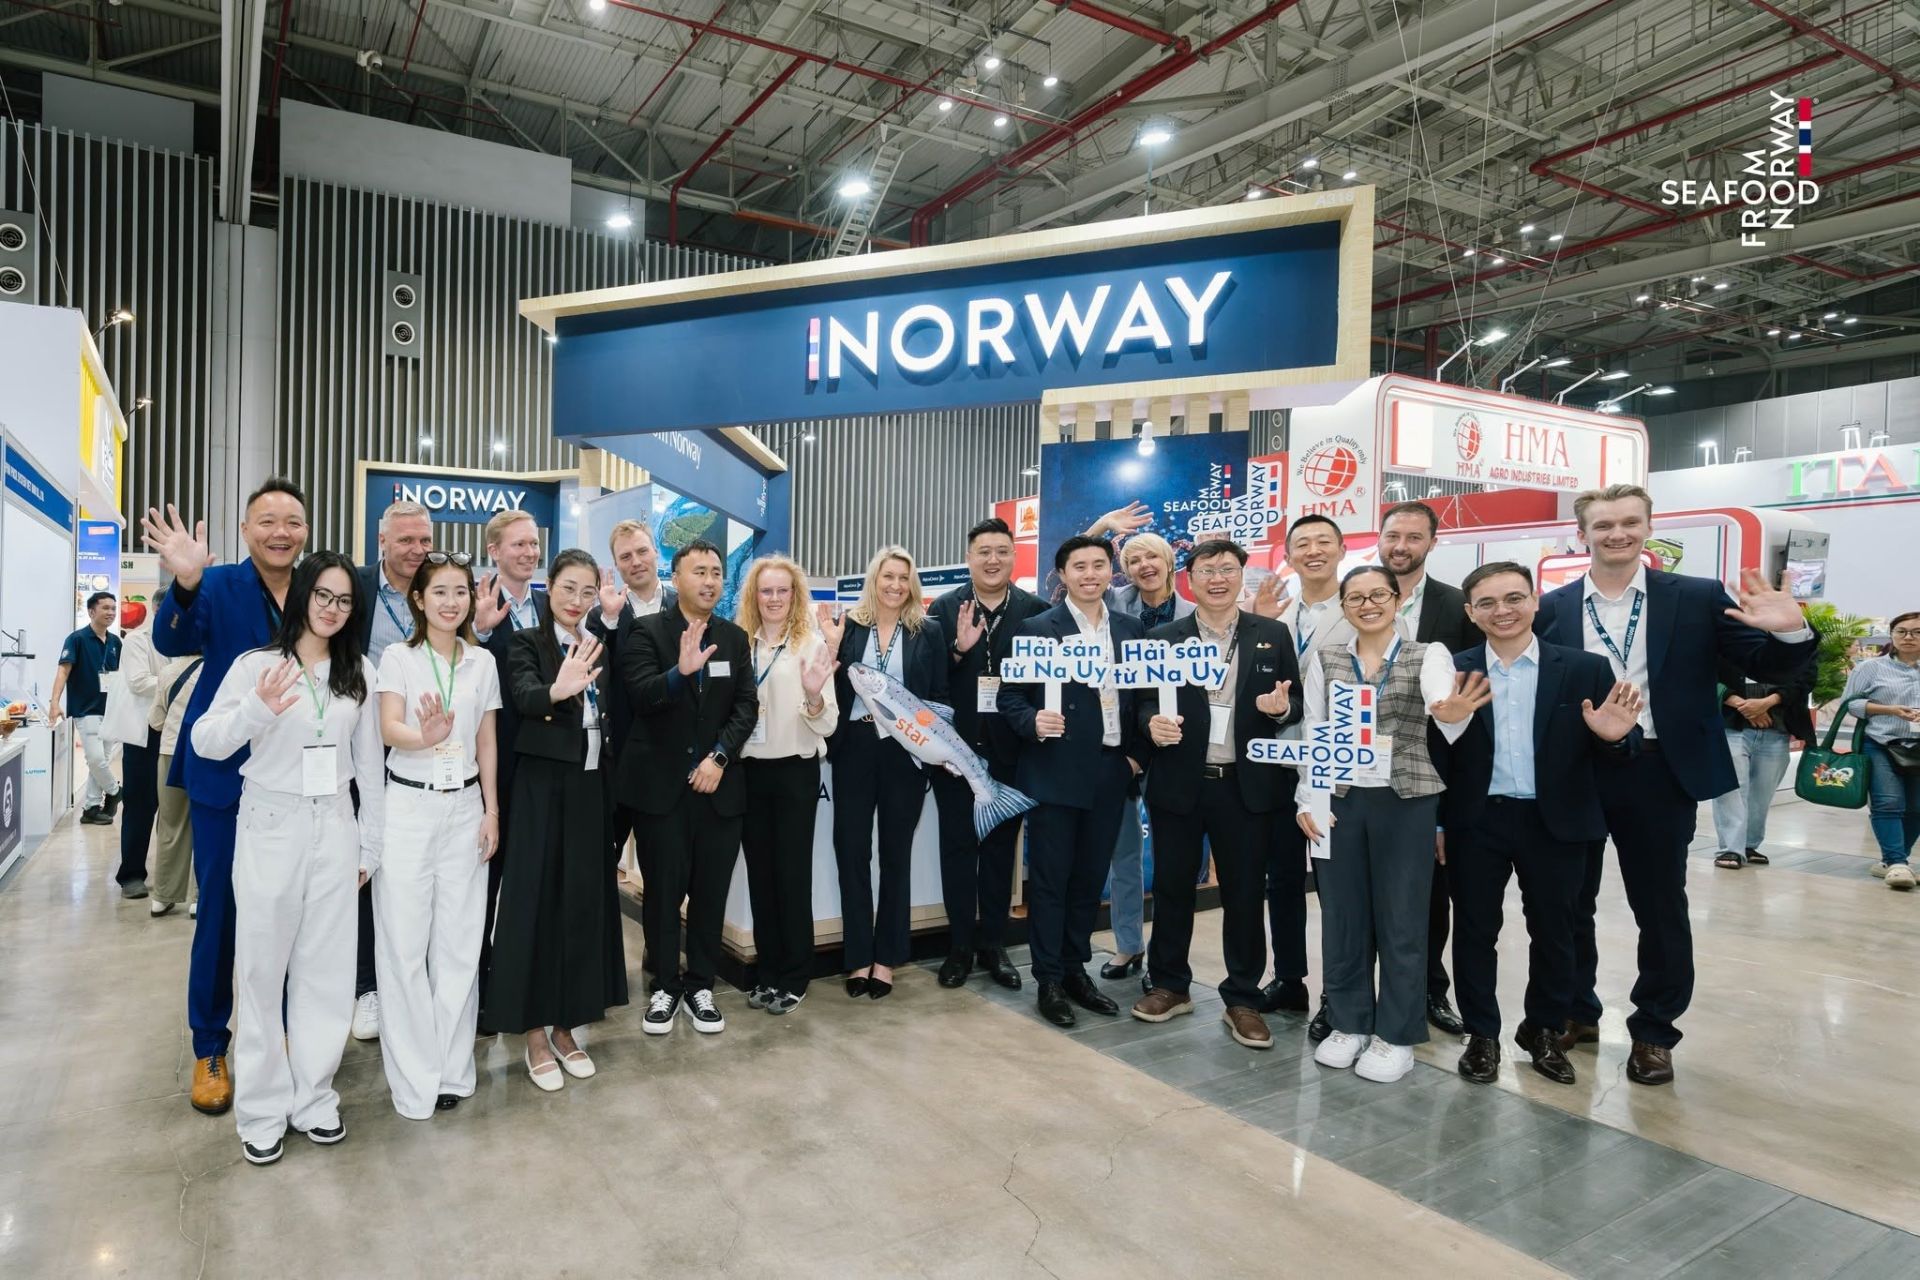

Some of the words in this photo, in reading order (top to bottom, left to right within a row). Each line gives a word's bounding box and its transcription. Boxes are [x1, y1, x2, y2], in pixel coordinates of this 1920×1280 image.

[828, 270, 1232, 379] NORWAY
[670, 430, 702, 470] Norway
[1301, 440, 1324, 463] Believe
[1335, 434, 1361, 450] Quality
[1356, 448, 1369, 465] only
[1505, 422, 1570, 468] HMA
[1456, 461, 1481, 479] HMA
[1489, 466, 1509, 480] AGRO
[1511, 469, 1552, 485] INDUSTRIES
[1552, 474, 1578, 489] LIMITED
[402, 483, 526, 512] NORWAY
[1163, 500, 1231, 513] SEAFOOD
[1198, 487, 1209, 517] ROM
[1250, 464, 1266, 538] NORWAY
[1301, 499, 1356, 516] HMA
[1190, 510, 1279, 532] SEAFOOD
[1015, 639, 1053, 657] Hải
[1062, 640, 1101, 657] sản
[1125, 643, 1165, 662] Hải
[1175, 640, 1218, 659] sản
[1003, 662, 1026, 678] từ
[1034, 660, 1067, 678] Na
[1077, 660, 1107, 683] Uy
[1114, 667, 1138, 684] từ
[1146, 664, 1182, 683] Na
[1192, 661, 1225, 686] Uy
[895, 718, 930, 747] star
[1334, 683, 1354, 782] NORWAY
[1251, 742, 1375, 766] SEAFOOD
[1312, 725, 1331, 790] FROM
